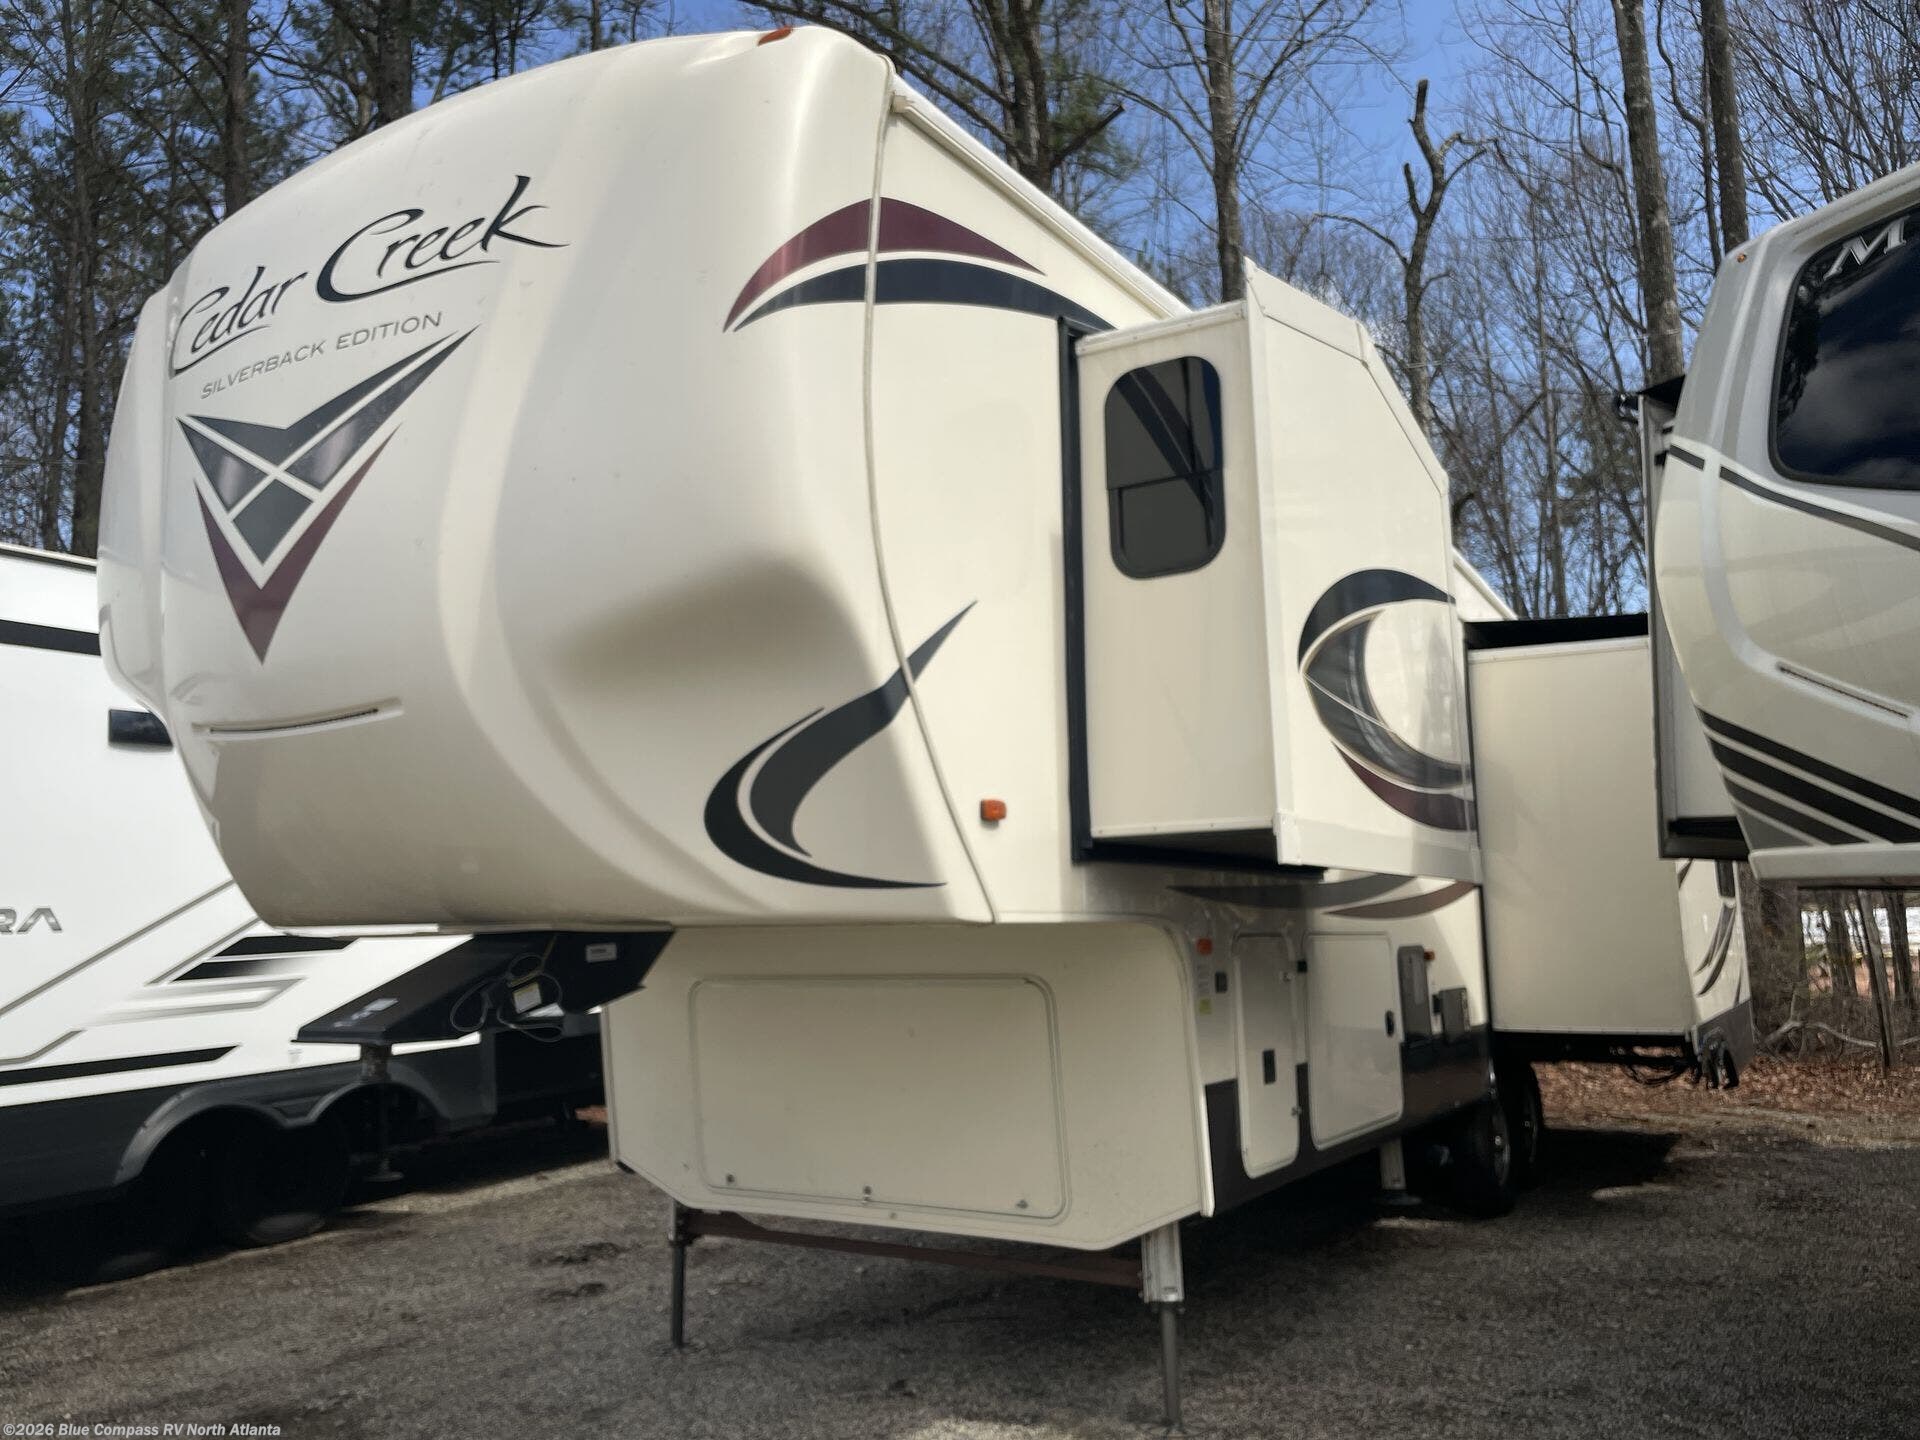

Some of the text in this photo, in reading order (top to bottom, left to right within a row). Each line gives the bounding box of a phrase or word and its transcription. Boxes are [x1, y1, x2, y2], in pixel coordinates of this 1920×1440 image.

[169, 175, 570, 379] Cedar Creek
[201, 311, 442, 399] SILVERBACK EDITION
